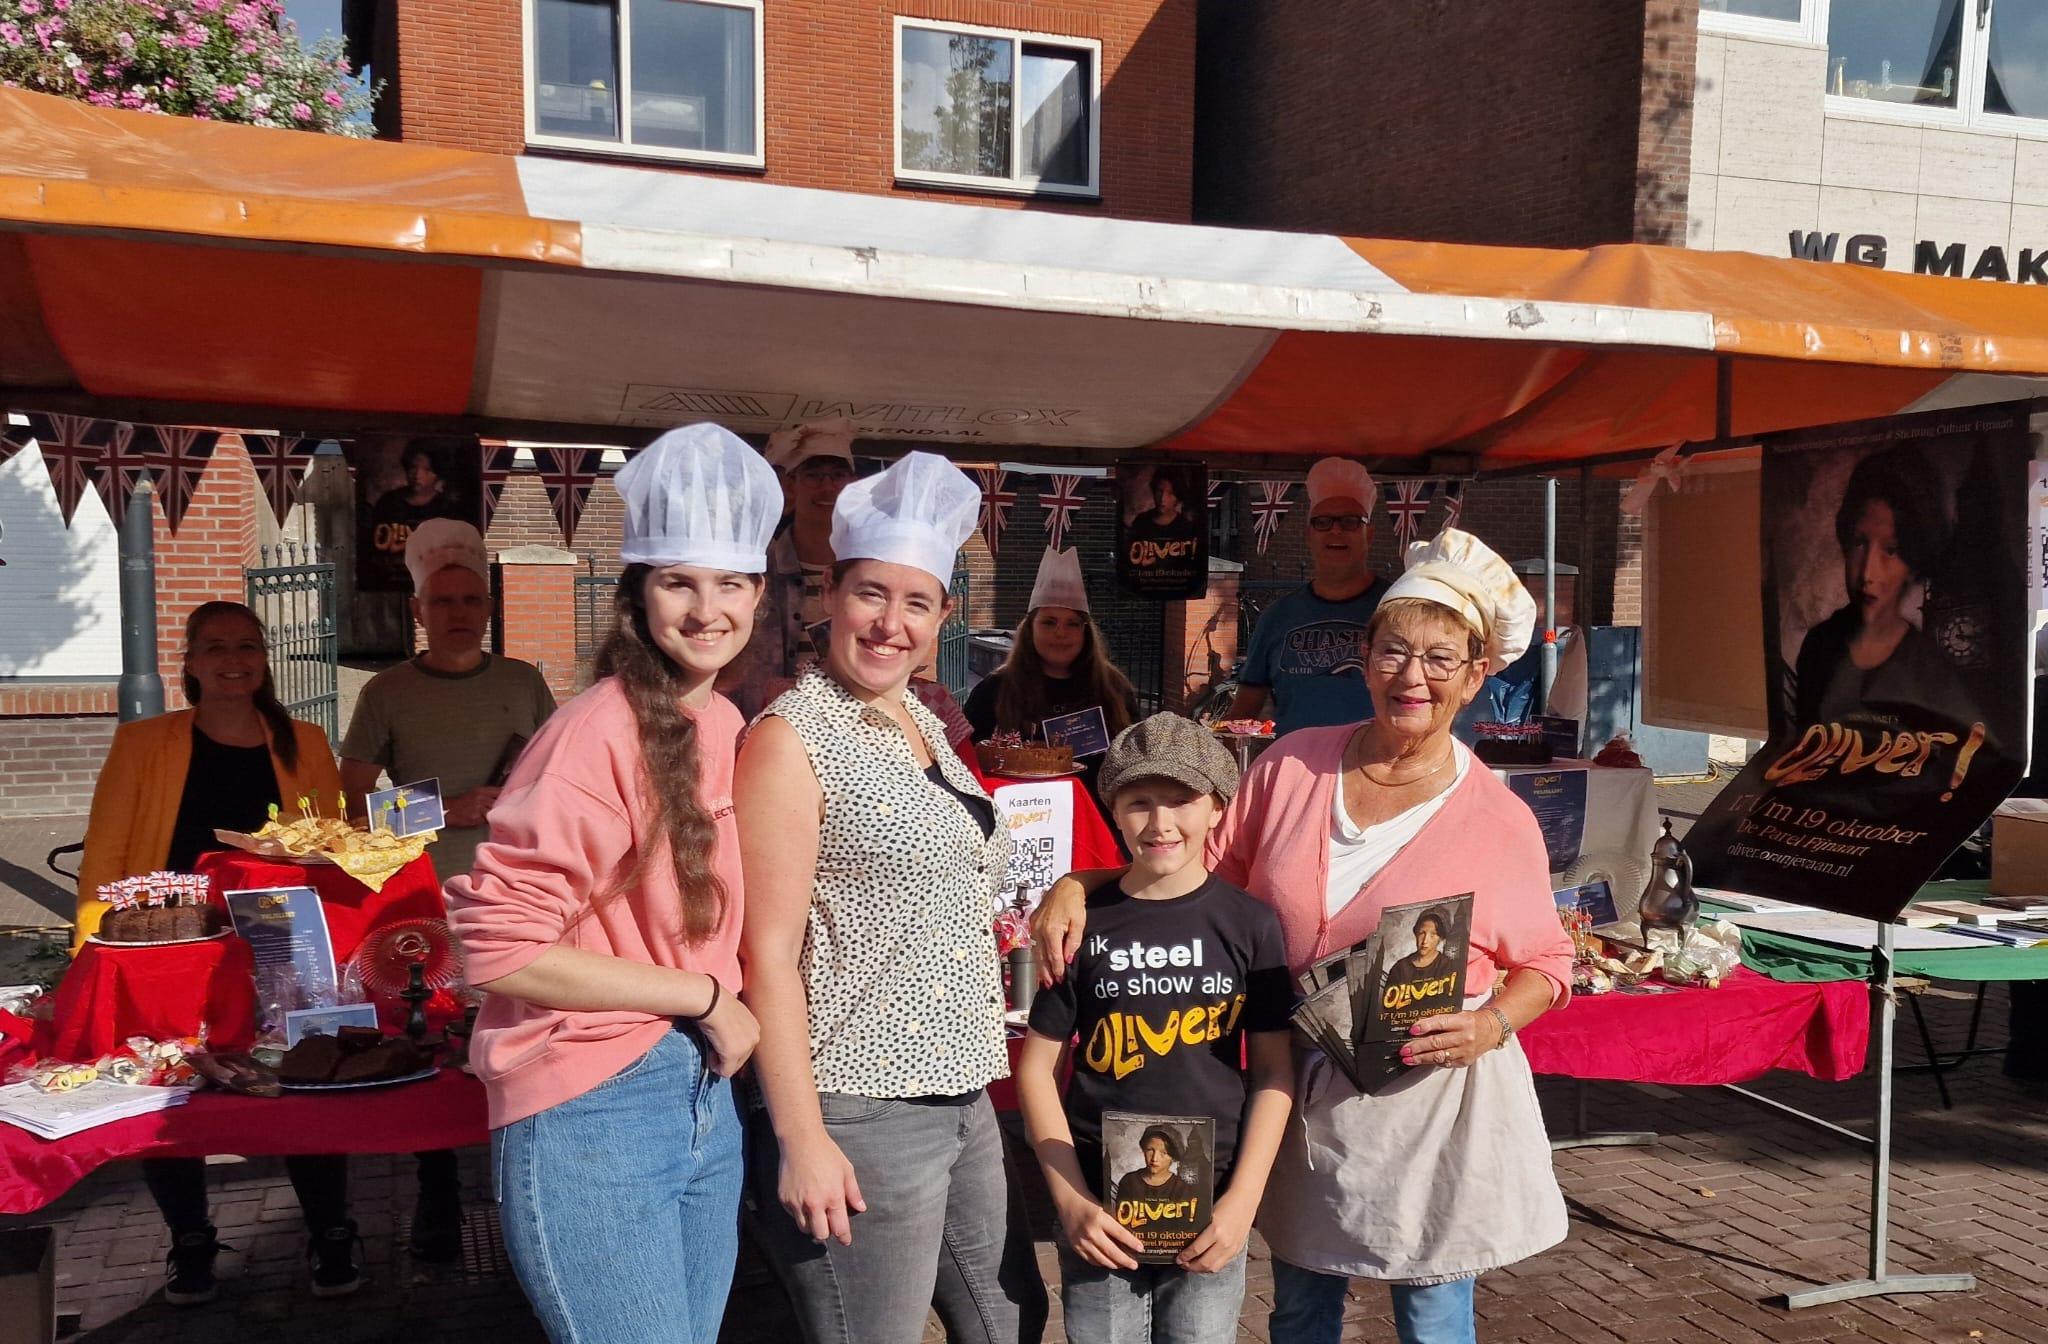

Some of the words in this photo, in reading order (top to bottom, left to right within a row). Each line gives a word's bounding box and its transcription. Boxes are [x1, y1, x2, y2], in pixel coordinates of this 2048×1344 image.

[1789, 229, 1888, 270] WG
[856, 426, 985, 437] SENDAAL
[1008, 797, 1051, 808] Kaarten
[1794, 808, 1827, 829] 19
[1826, 818, 1928, 845] oktober
[1759, 825, 1806, 847] Parel
[1803, 836, 1871, 857] Fijnaart
[1089, 935, 1109, 956] ik
[1109, 938, 1203, 971] steel
[1095, 978, 1120, 999] de
[1127, 973, 1194, 995] show
[1201, 972, 1233, 994] als
[1421, 1005, 1455, 1017] oktober
[1147, 1231, 1157, 1239] 19
[1159, 1231, 1198, 1239] oktober
